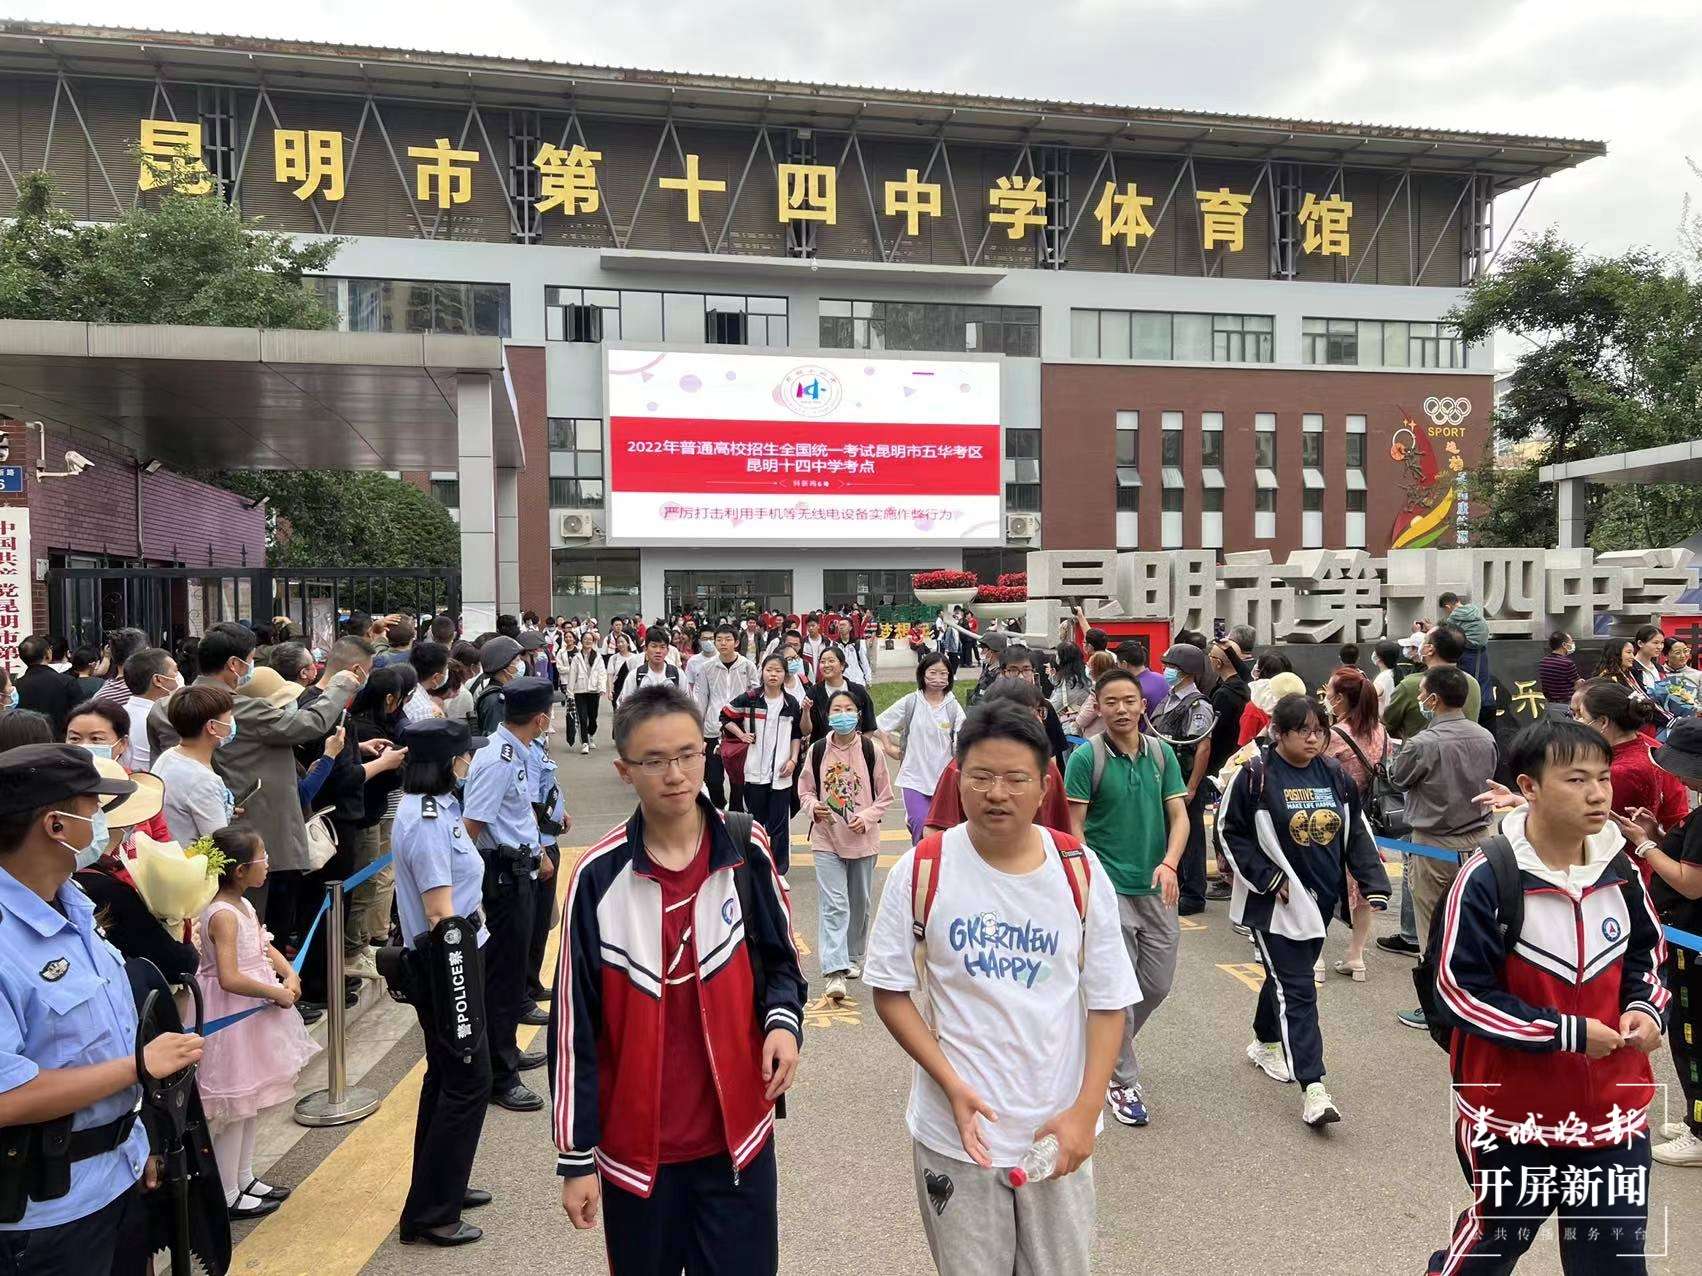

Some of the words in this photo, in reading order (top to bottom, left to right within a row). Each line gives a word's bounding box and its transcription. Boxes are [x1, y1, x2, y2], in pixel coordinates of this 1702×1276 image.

[139, 118, 1354, 257] 昆明市第十四中学体育馆
[1427, 427, 1466, 437] SPORT
[627, 439, 983, 459] 2022年普通高校招生全国统一考试昆明市五华考区
[746, 458, 875, 473] 昆明十四中学考点
[663, 506, 953, 521] 严厉打击利用手机等无线电设备实施作弊行为
[1027, 548, 1701, 650] 昆明市第十四中学
[1283, 787, 1315, 801] POSITIVE
[963, 947, 1042, 989] HAPPY
